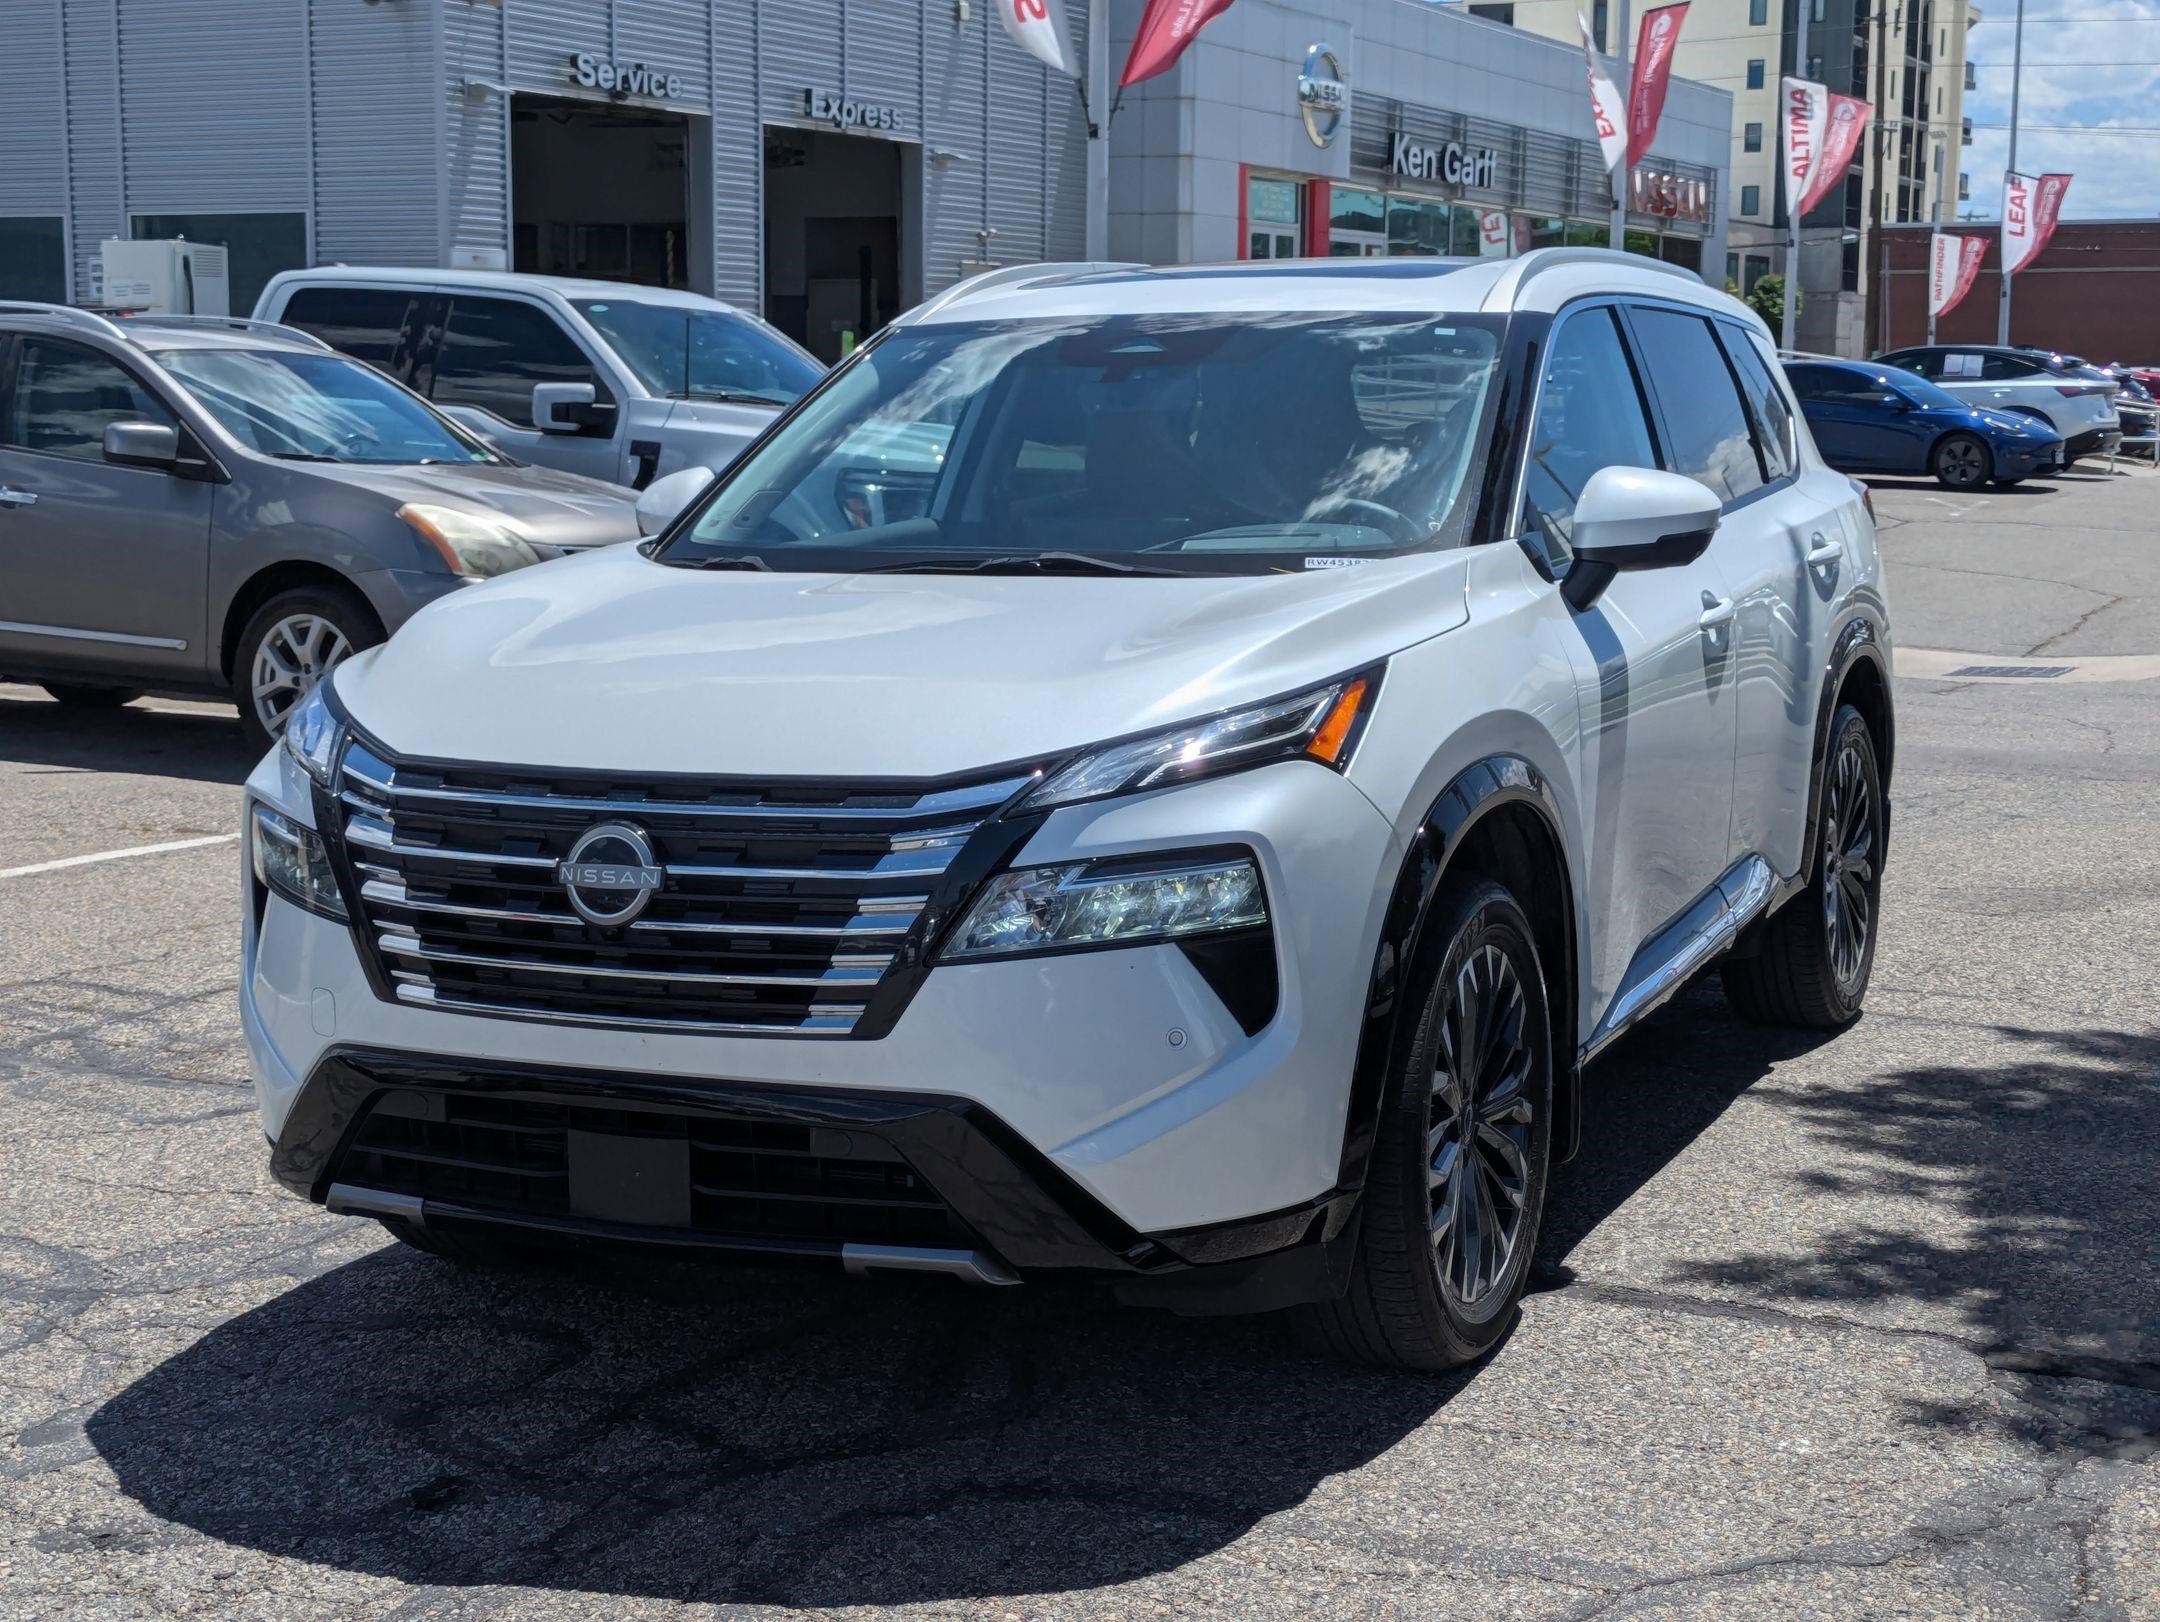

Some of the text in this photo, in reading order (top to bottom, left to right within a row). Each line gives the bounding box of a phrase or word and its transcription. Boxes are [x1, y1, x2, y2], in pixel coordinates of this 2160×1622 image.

[574, 52, 682, 98] Service
[808, 88, 904, 130] Express
[1789, 88, 1811, 181] ALTIMA
[1392, 131, 1498, 188] Ken Garff
[2008, 177, 2028, 238] LEAF
[1934, 237, 1946, 301] PATHFINDER
[560, 866, 658, 885] NISSAN
